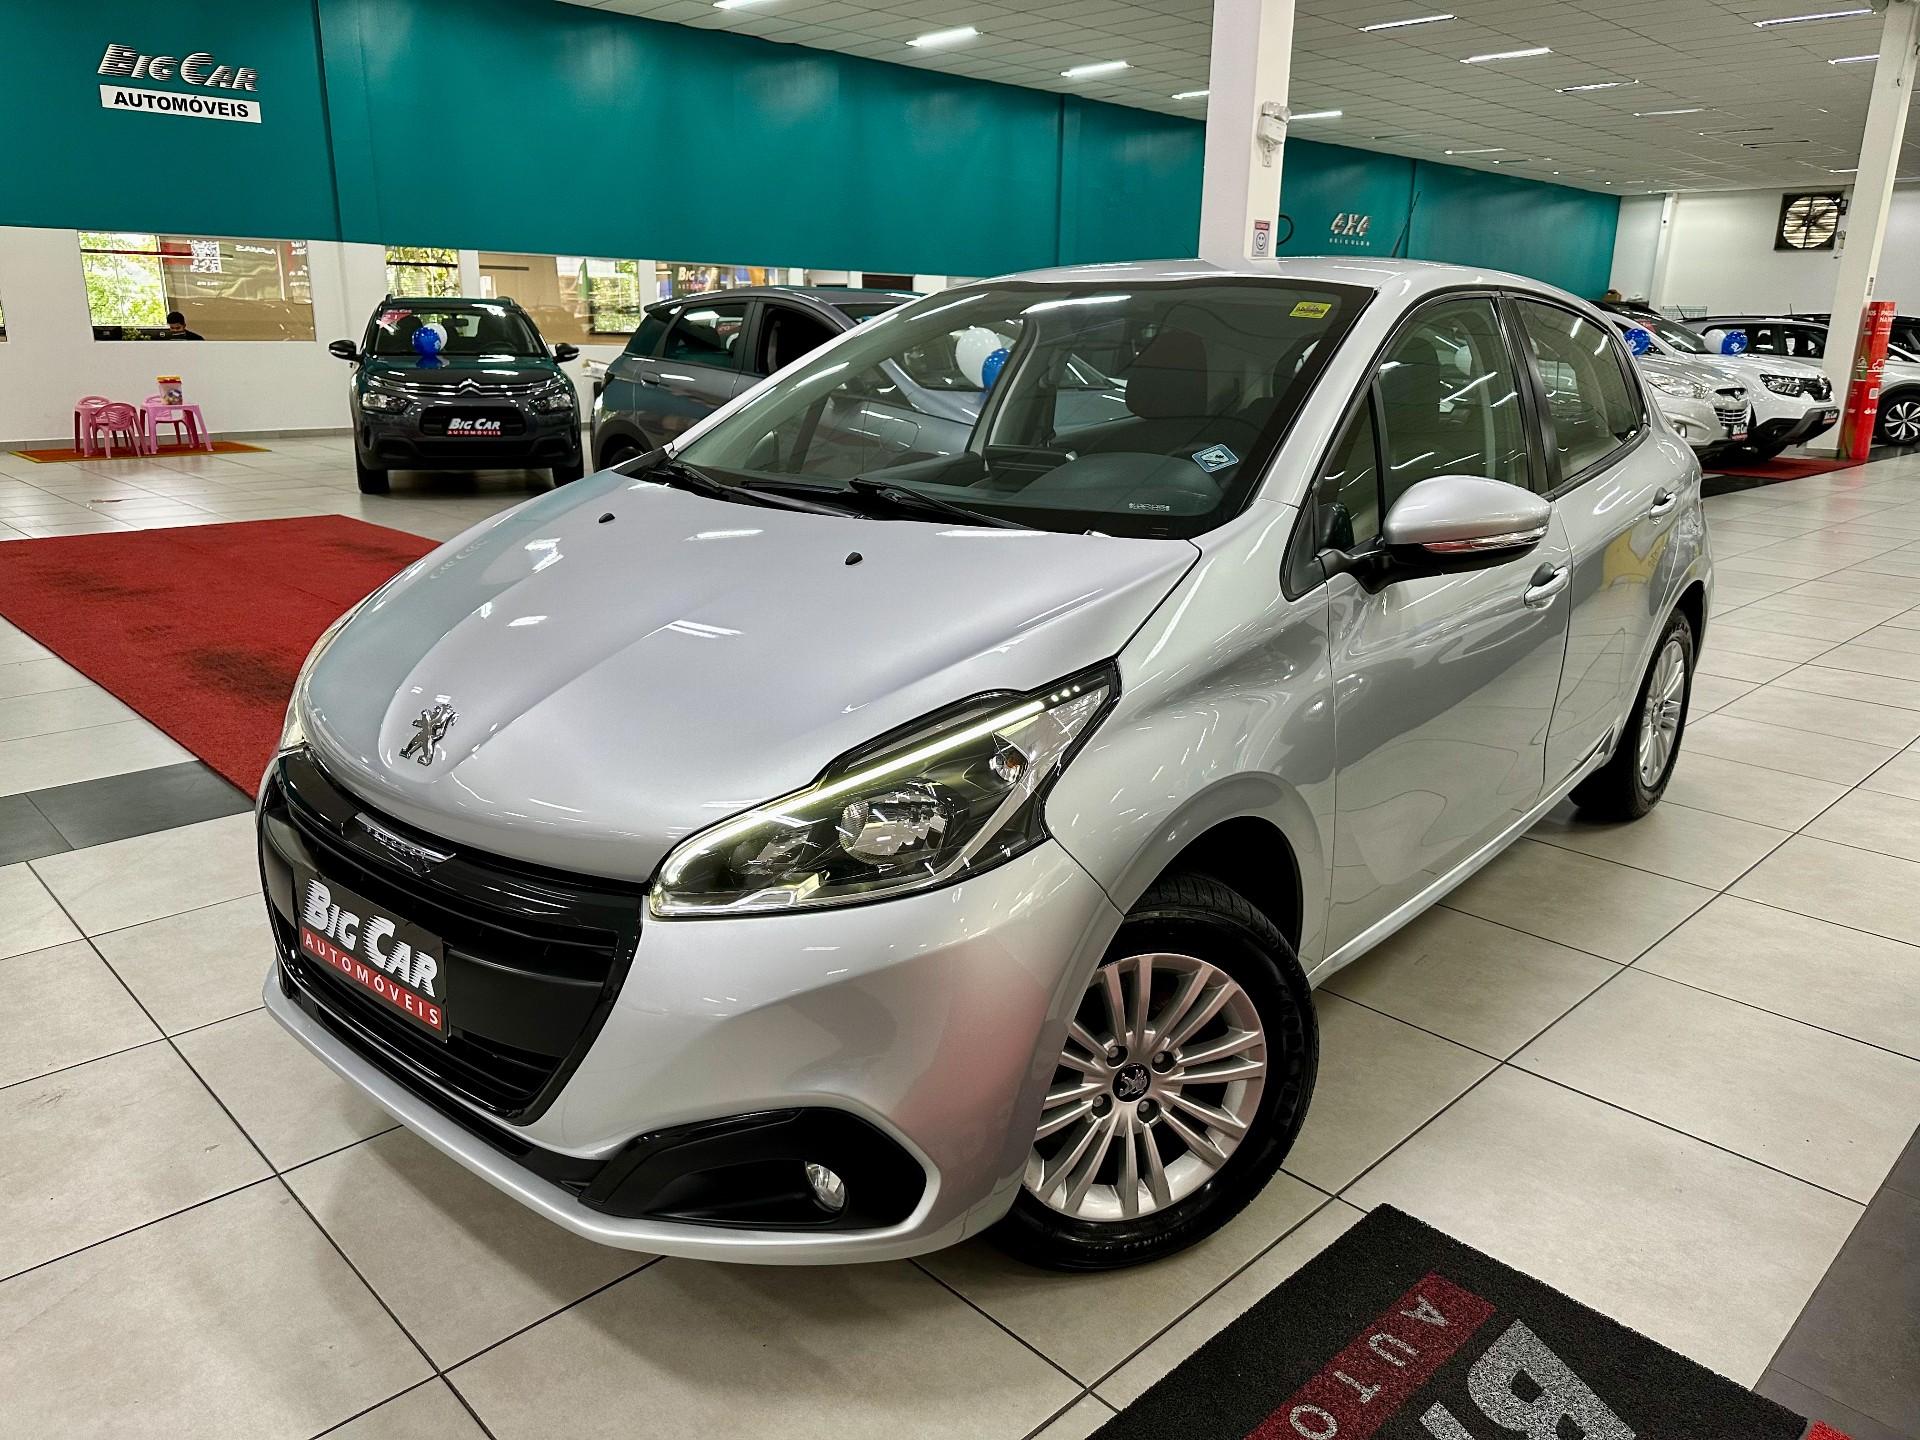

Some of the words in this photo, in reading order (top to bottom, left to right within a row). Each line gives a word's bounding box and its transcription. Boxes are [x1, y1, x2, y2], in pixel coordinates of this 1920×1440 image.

[97, 44, 178, 81] BIG
[180, 52, 259, 92] CAR
[113, 91, 249, 118] AUTOMÓVEIS
[448, 418, 473, 430] BIG
[474, 418, 501, 430] CAR
[303, 878, 360, 951] BIG
[362, 914, 438, 998] CAR
[305, 932, 440, 1026] AUTOMÓVEIS
